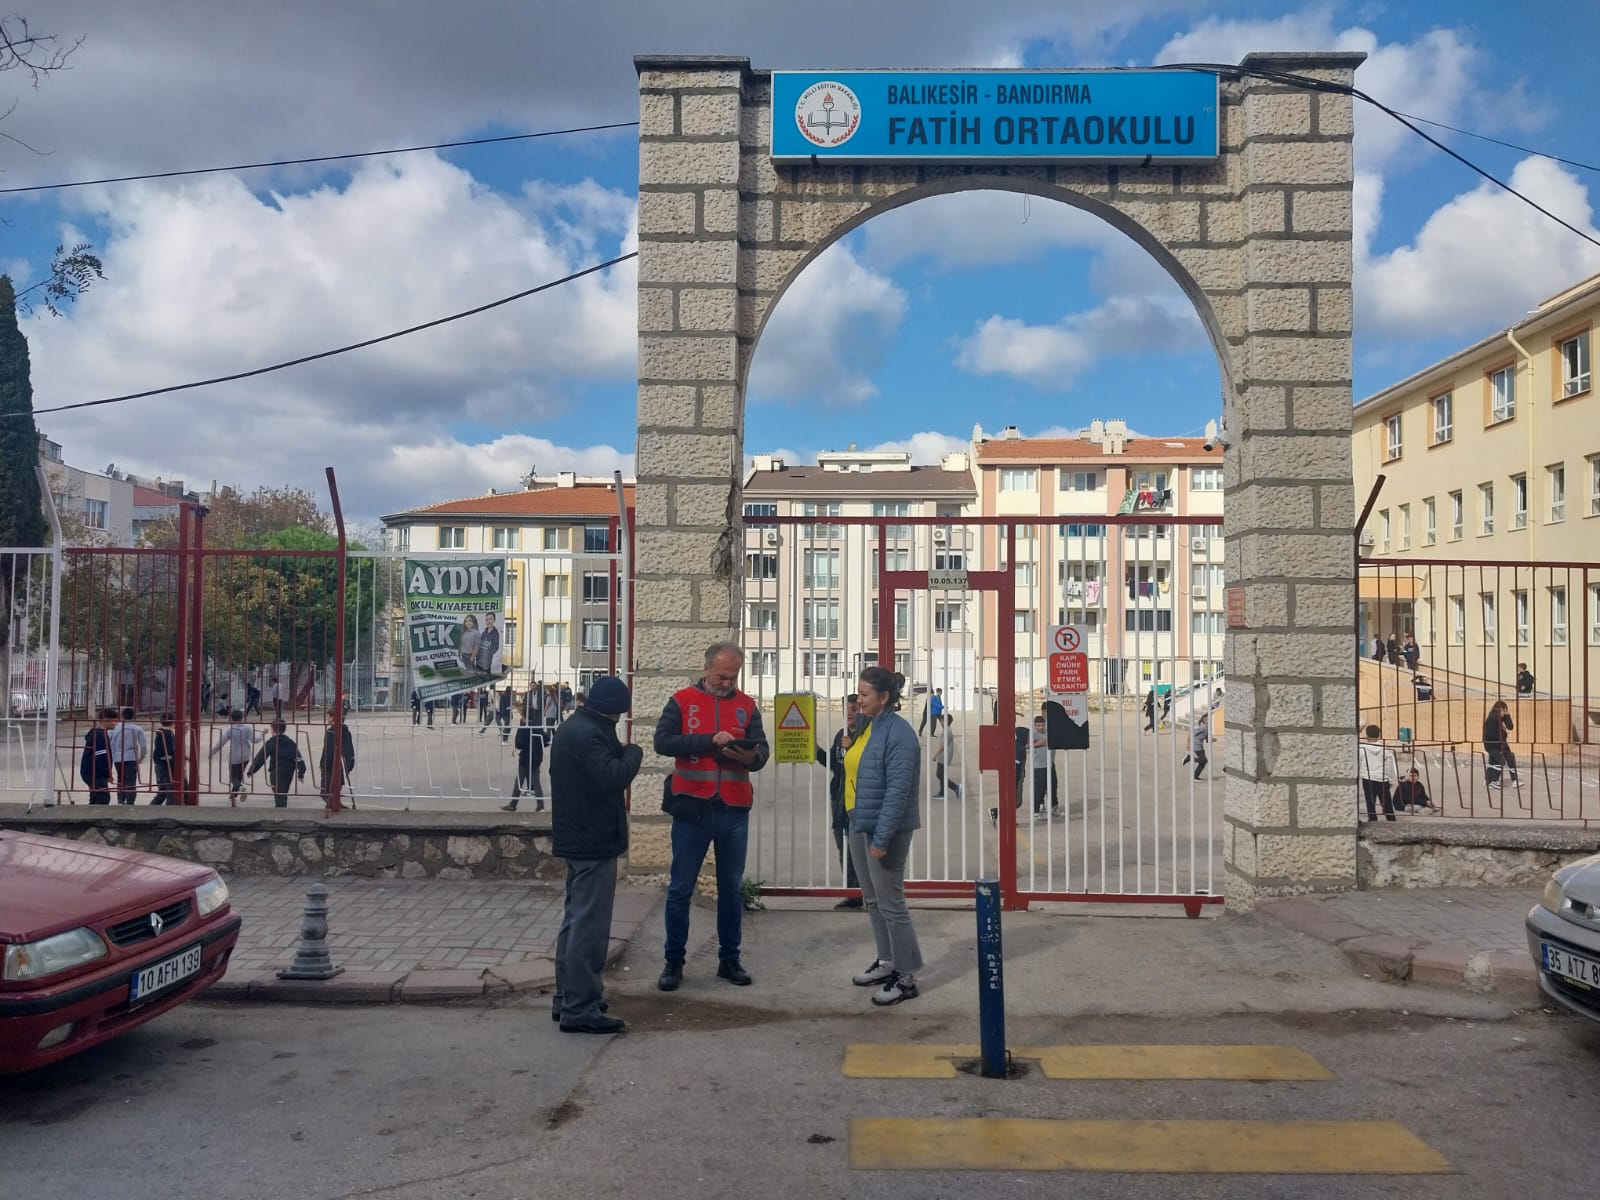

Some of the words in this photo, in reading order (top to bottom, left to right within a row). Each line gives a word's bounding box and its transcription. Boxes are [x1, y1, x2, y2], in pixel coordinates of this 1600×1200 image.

[887, 79, 978, 105] BALIKESİR
[997, 84, 1092, 105] BANDIRMA
[888, 110, 981, 145] FATİH
[994, 115, 1195, 145] ORTAOKULU
[407, 566, 502, 595] AYDIN
[410, 600, 434, 610] OKUL
[436, 599, 499, 611] KIYAFETLERİ
[413, 624, 456, 649] TEK
[140, 970, 154, 993] 10
[157, 959, 179, 987] AFH
[181, 949, 200, 974] 139
[1549, 949, 1561, 971] 35
[1567, 955, 1587, 981] ATZ
[1592, 964, 1600, 985] 8
